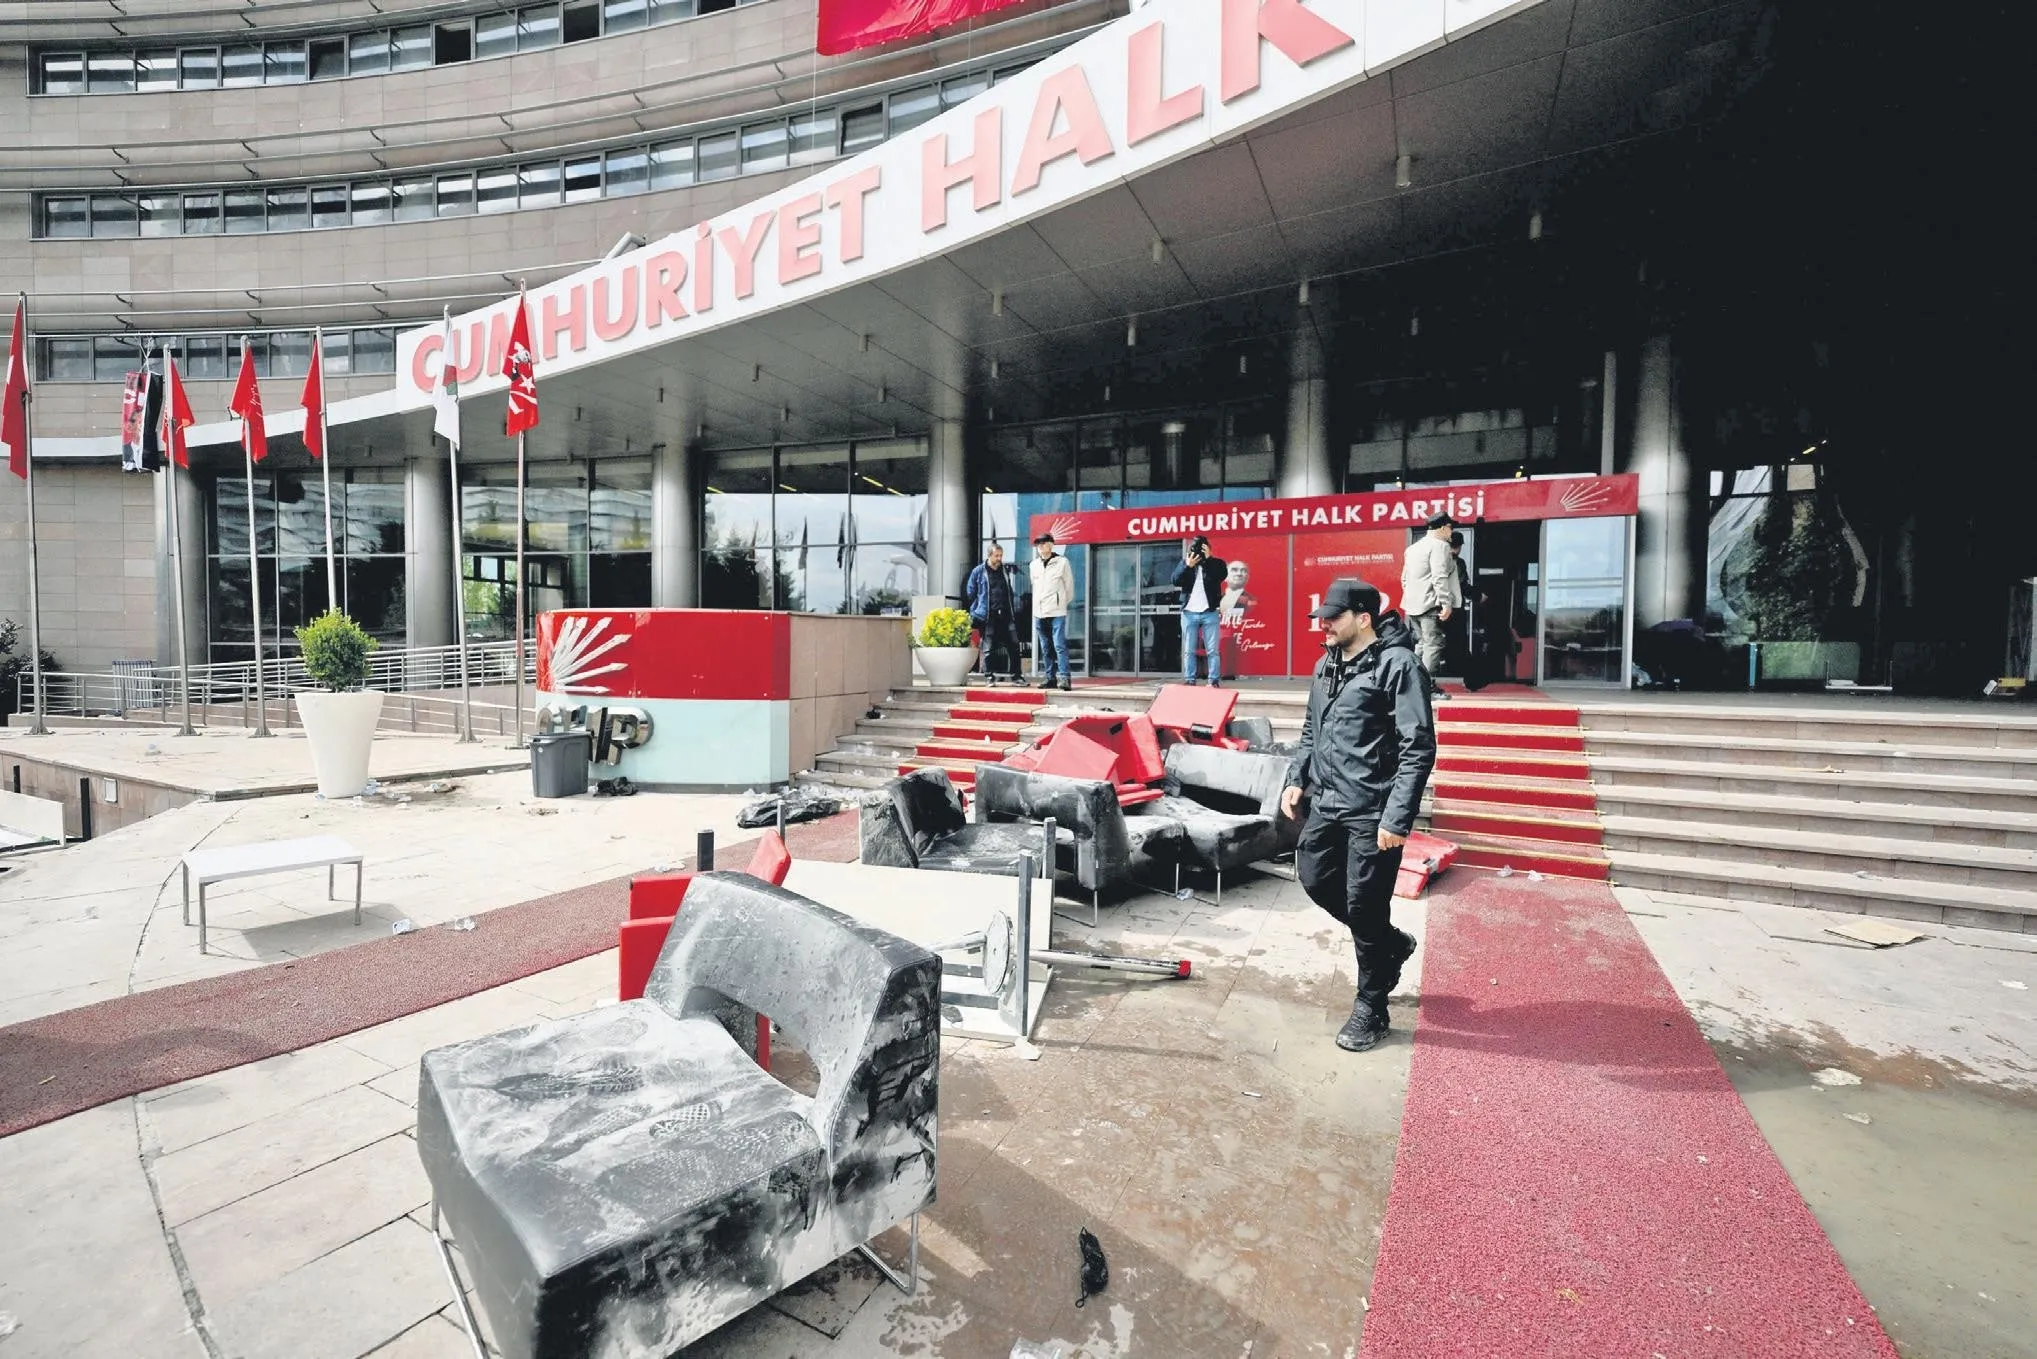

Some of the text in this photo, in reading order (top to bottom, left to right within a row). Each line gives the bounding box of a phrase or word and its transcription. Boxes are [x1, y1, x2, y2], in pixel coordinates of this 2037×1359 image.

[921, 0, 1356, 233] HALK
[1127, 490, 1485, 537] CUMHURİYET HALK PARTİSİ
